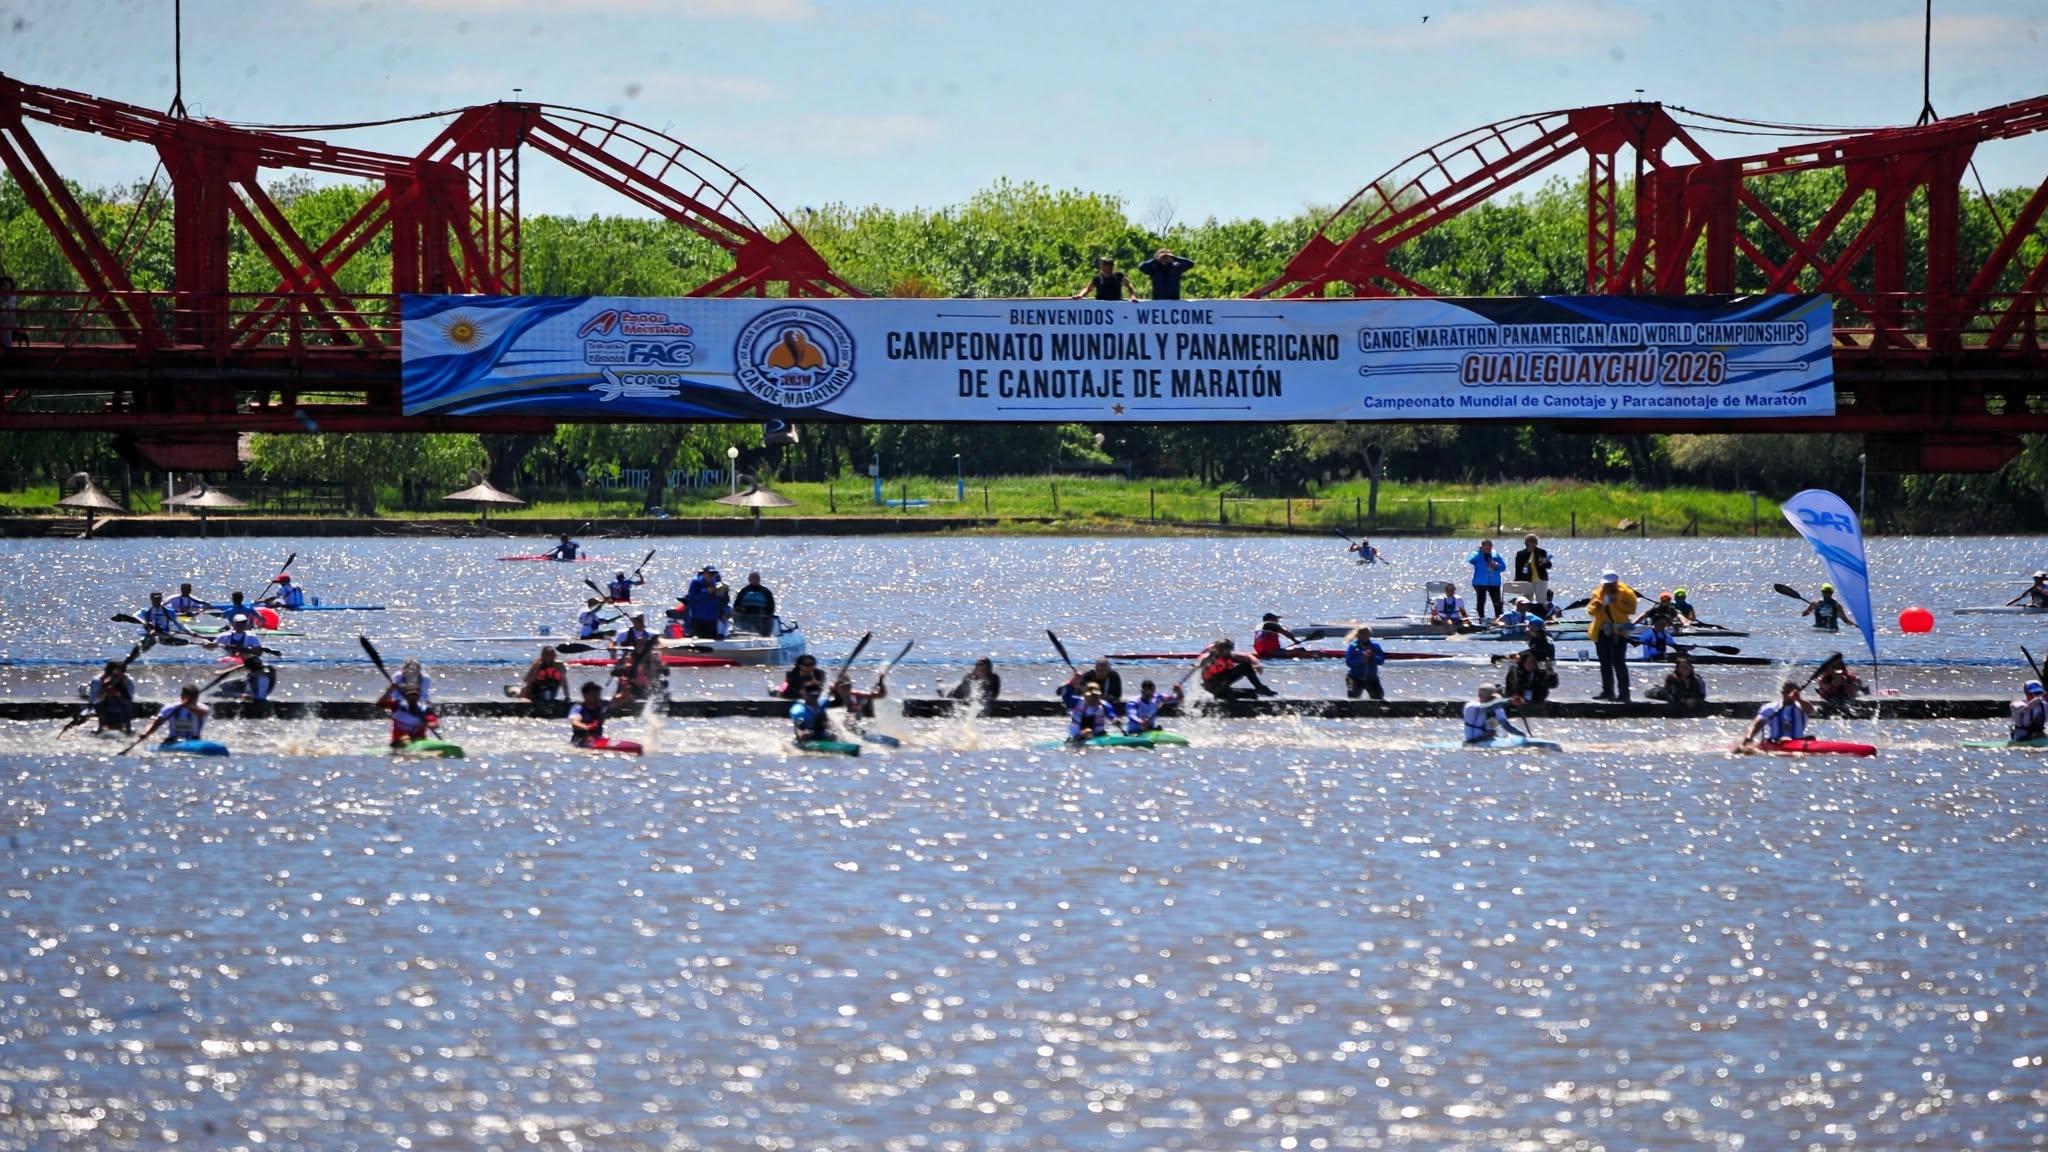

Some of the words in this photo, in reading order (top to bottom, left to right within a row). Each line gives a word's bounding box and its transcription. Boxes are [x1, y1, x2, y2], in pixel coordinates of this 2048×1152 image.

[1009, 309, 1114, 326] BIENVENIDOS
[1136, 309, 1214, 325] WELCOME
[886, 331, 1044, 362] CAMPEONATO
[1051, 332, 1152, 362] MUNDIAL
[1155, 333, 1169, 361] Y
[1176, 332, 1340, 362] PANAMERICANO
[1362, 330, 1412, 350] CANOE
[1416, 328, 1497, 347] MARATHON
[1503, 325, 1604, 346] PANAMERICAN
[1610, 325, 1639, 344] AND
[1644, 325, 1693, 344] WORLD
[1696, 323, 1806, 343] CHAMPIONSHIPS
[628, 343, 693, 364] FAC
[1463, 349, 1657, 384] GUALEGUAYCHÚ
[1662, 353, 1724, 384] 2026
[958, 368, 989, 398] DE
[999, 368, 1125, 398] CANOTAJE
[1133, 369, 1162, 398] DE
[1171, 364, 1283, 398] MARATÓN
[1363, 395, 1455, 410] Campeonato
[1459, 394, 1517, 408] Mundial
[1521, 394, 1539, 407] de
[1543, 394, 1606, 409] Canotaje
[1610, 398, 1619, 410] y
[1622, 394, 1719, 409] Paracanotaje
[1723, 394, 1740, 406] de
[1745, 391, 1807, 406] Maratón
